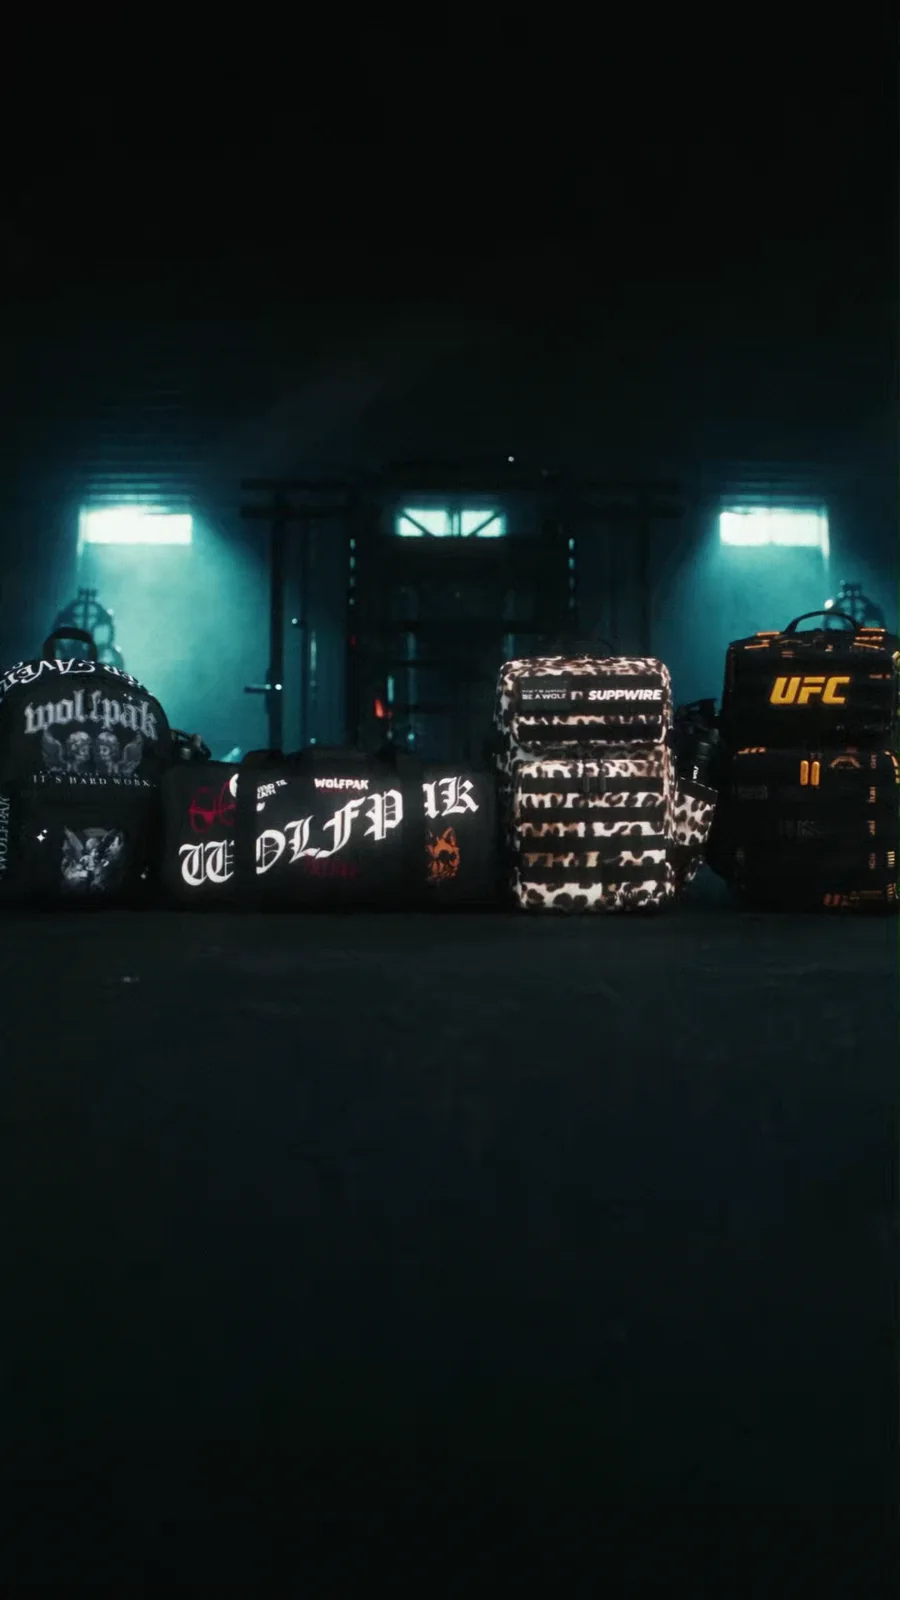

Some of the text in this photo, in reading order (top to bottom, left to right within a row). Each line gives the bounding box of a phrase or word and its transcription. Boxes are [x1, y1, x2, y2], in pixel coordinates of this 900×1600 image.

[588, 689, 663, 701] SUPPWIRE
[768, 675, 850, 705] UFC
[69, 776, 107, 785] HARD
[314, 777, 369, 790] WOLFPAK
